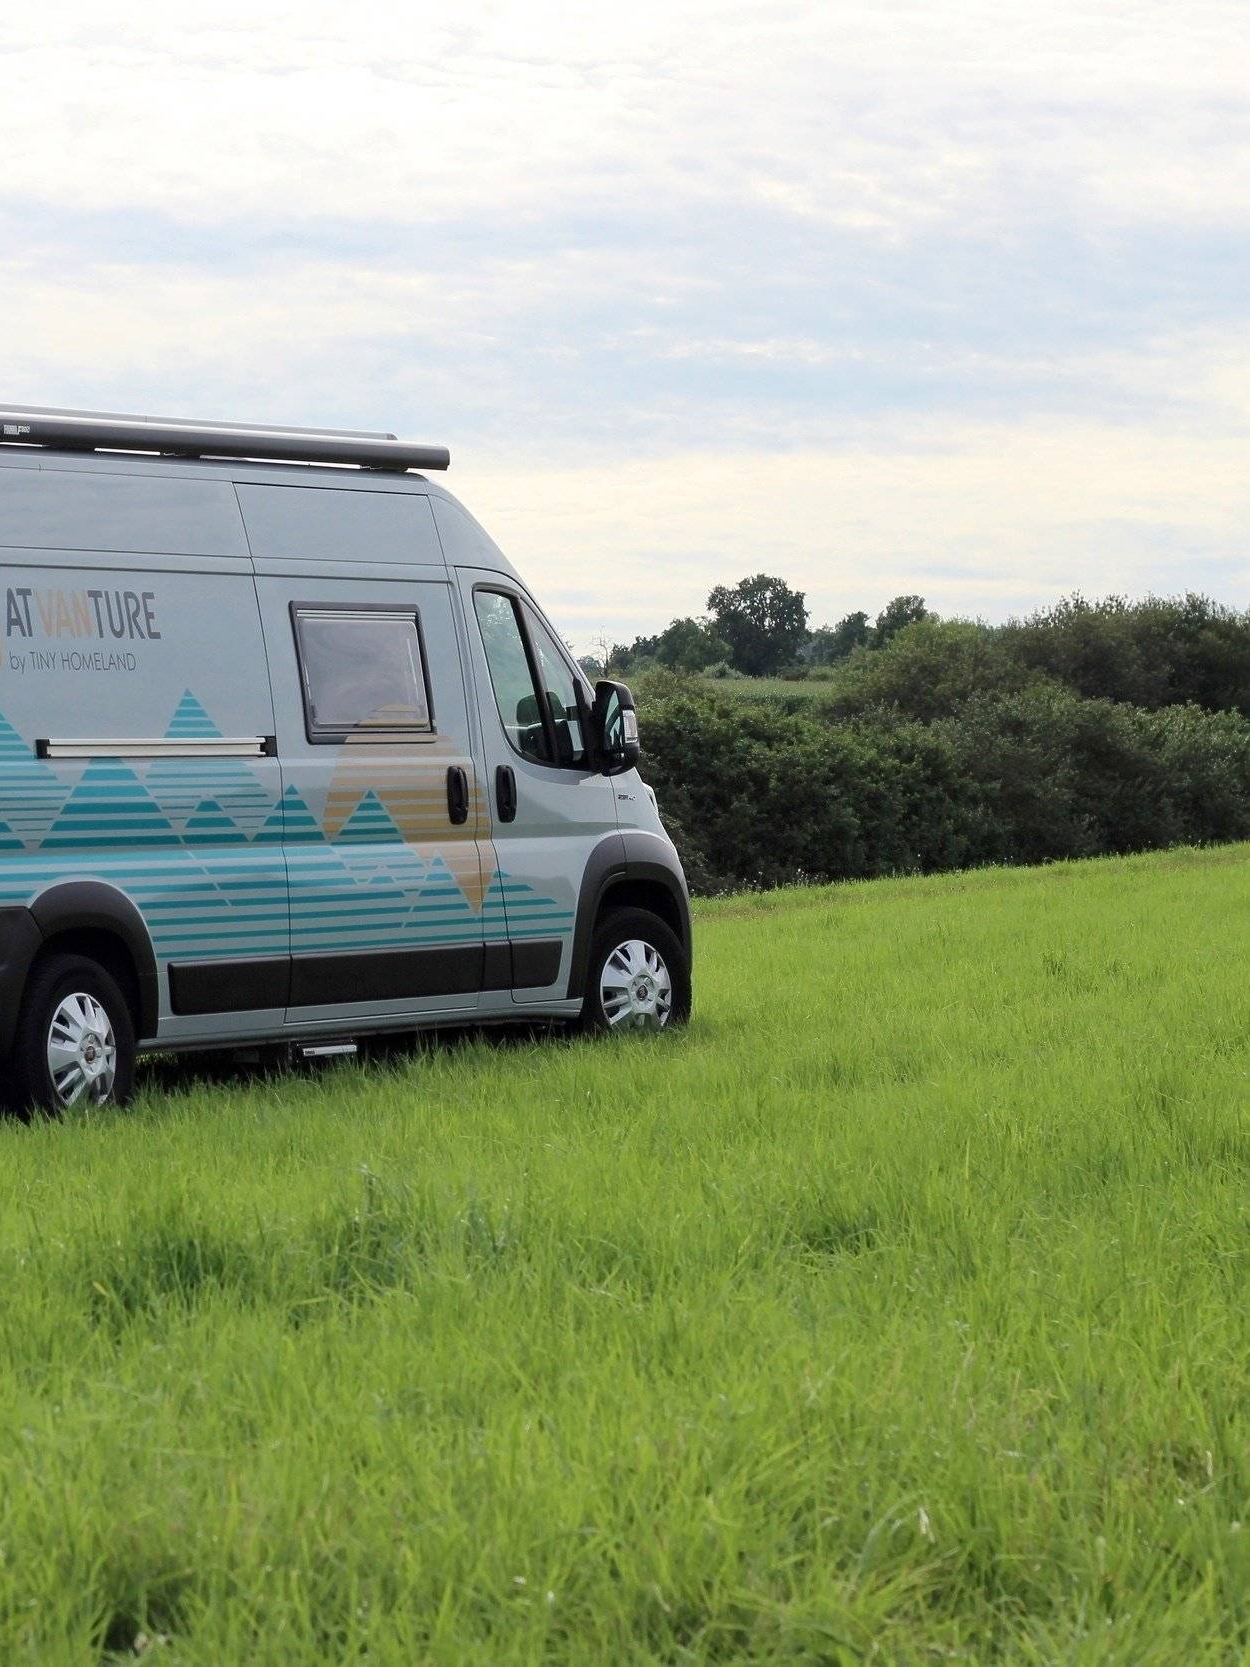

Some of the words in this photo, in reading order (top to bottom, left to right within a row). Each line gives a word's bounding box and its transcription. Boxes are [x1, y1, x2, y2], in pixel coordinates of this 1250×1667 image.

[6, 587, 161, 639] ATVANTURE
[10, 652, 25, 674] by
[30, 651, 56, 670] TINY
[62, 651, 136, 671] HOMELAND
